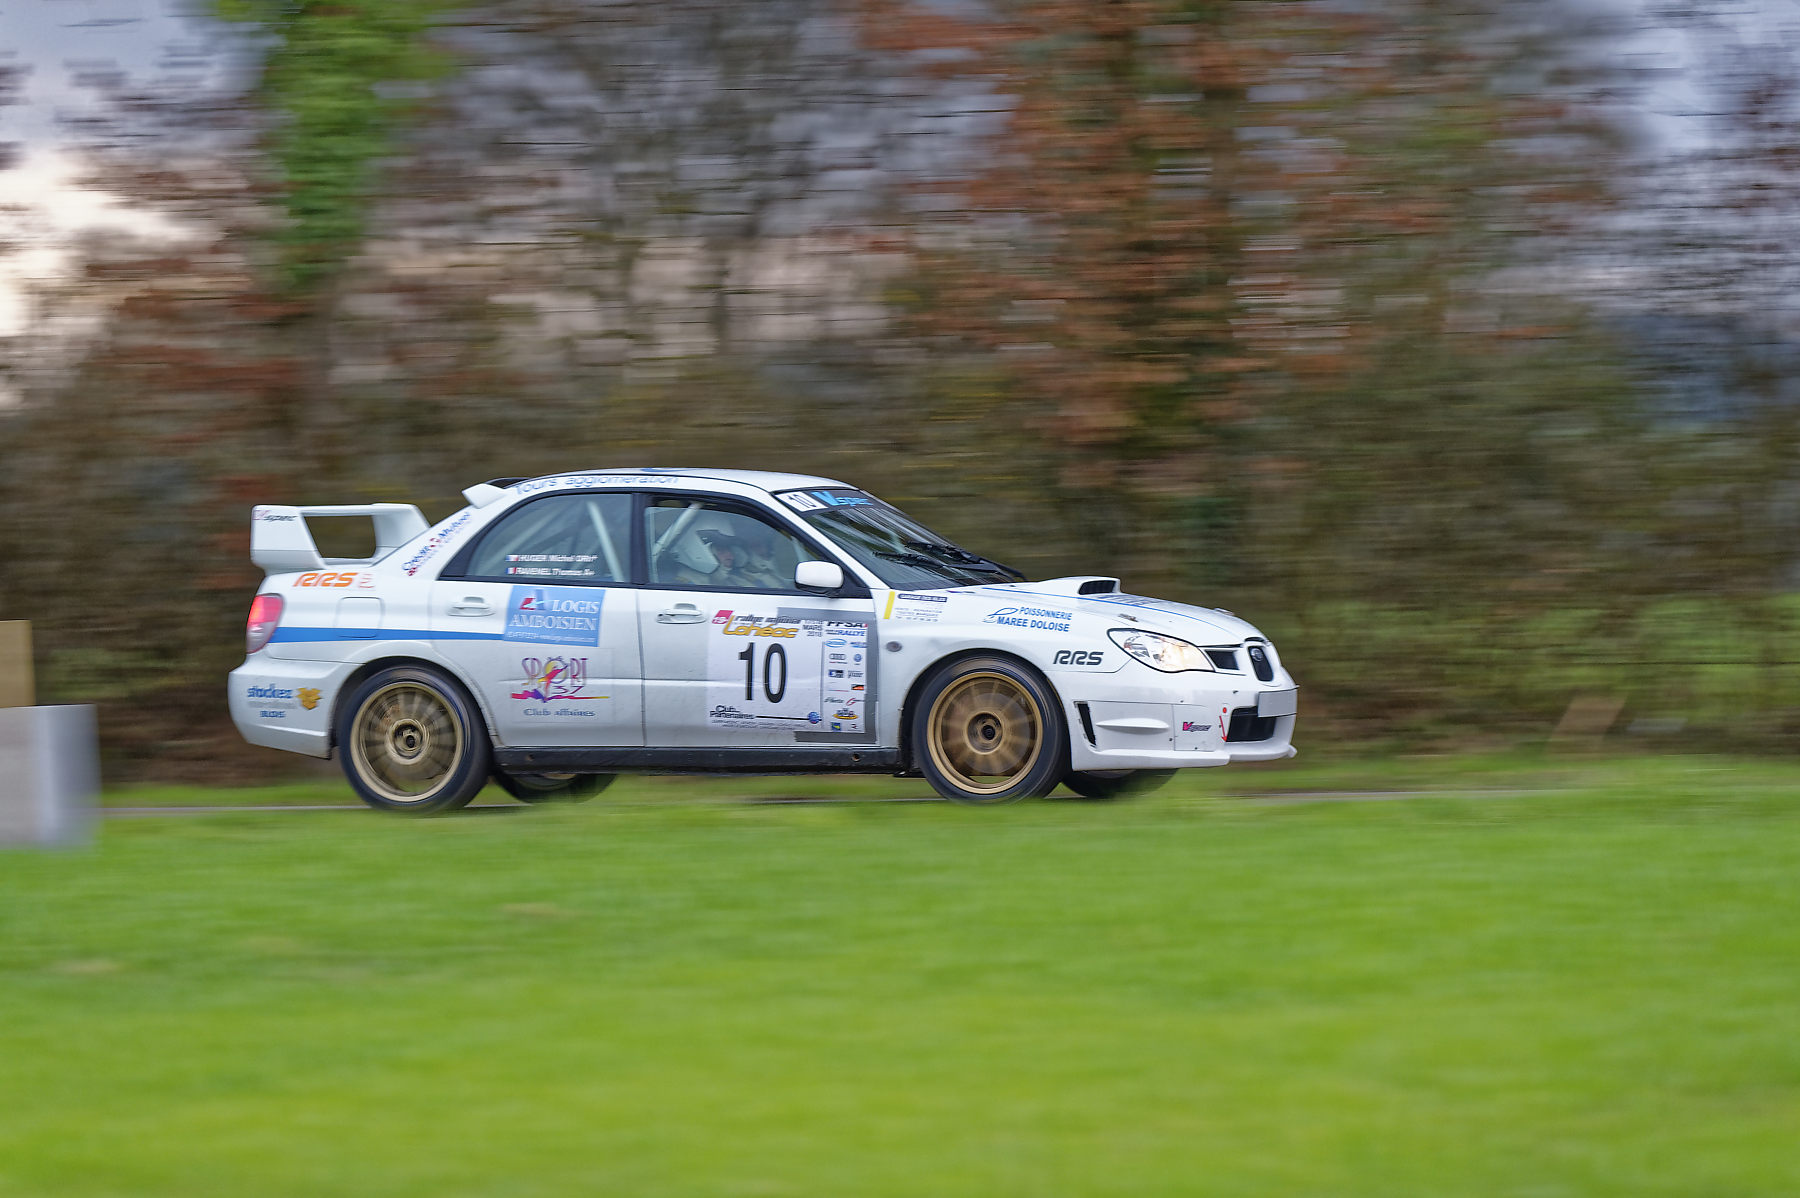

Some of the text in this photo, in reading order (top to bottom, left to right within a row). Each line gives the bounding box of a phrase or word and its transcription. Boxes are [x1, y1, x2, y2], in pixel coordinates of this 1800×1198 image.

[515, 477, 557, 494] Tours
[292, 572, 359, 588] RRS
[552, 599, 600, 614] LOGIS
[1019, 606, 1073, 620] POISSONNERIE
[508, 614, 598, 630] AMBOISIEN
[997, 616, 1070, 632] MAREE DOLOISE
[1053, 650, 1105, 666] RRS
[521, 657, 589, 686] SPORT
[738, 642, 787, 703] 10
[523, 708, 596, 717] Club affaires
